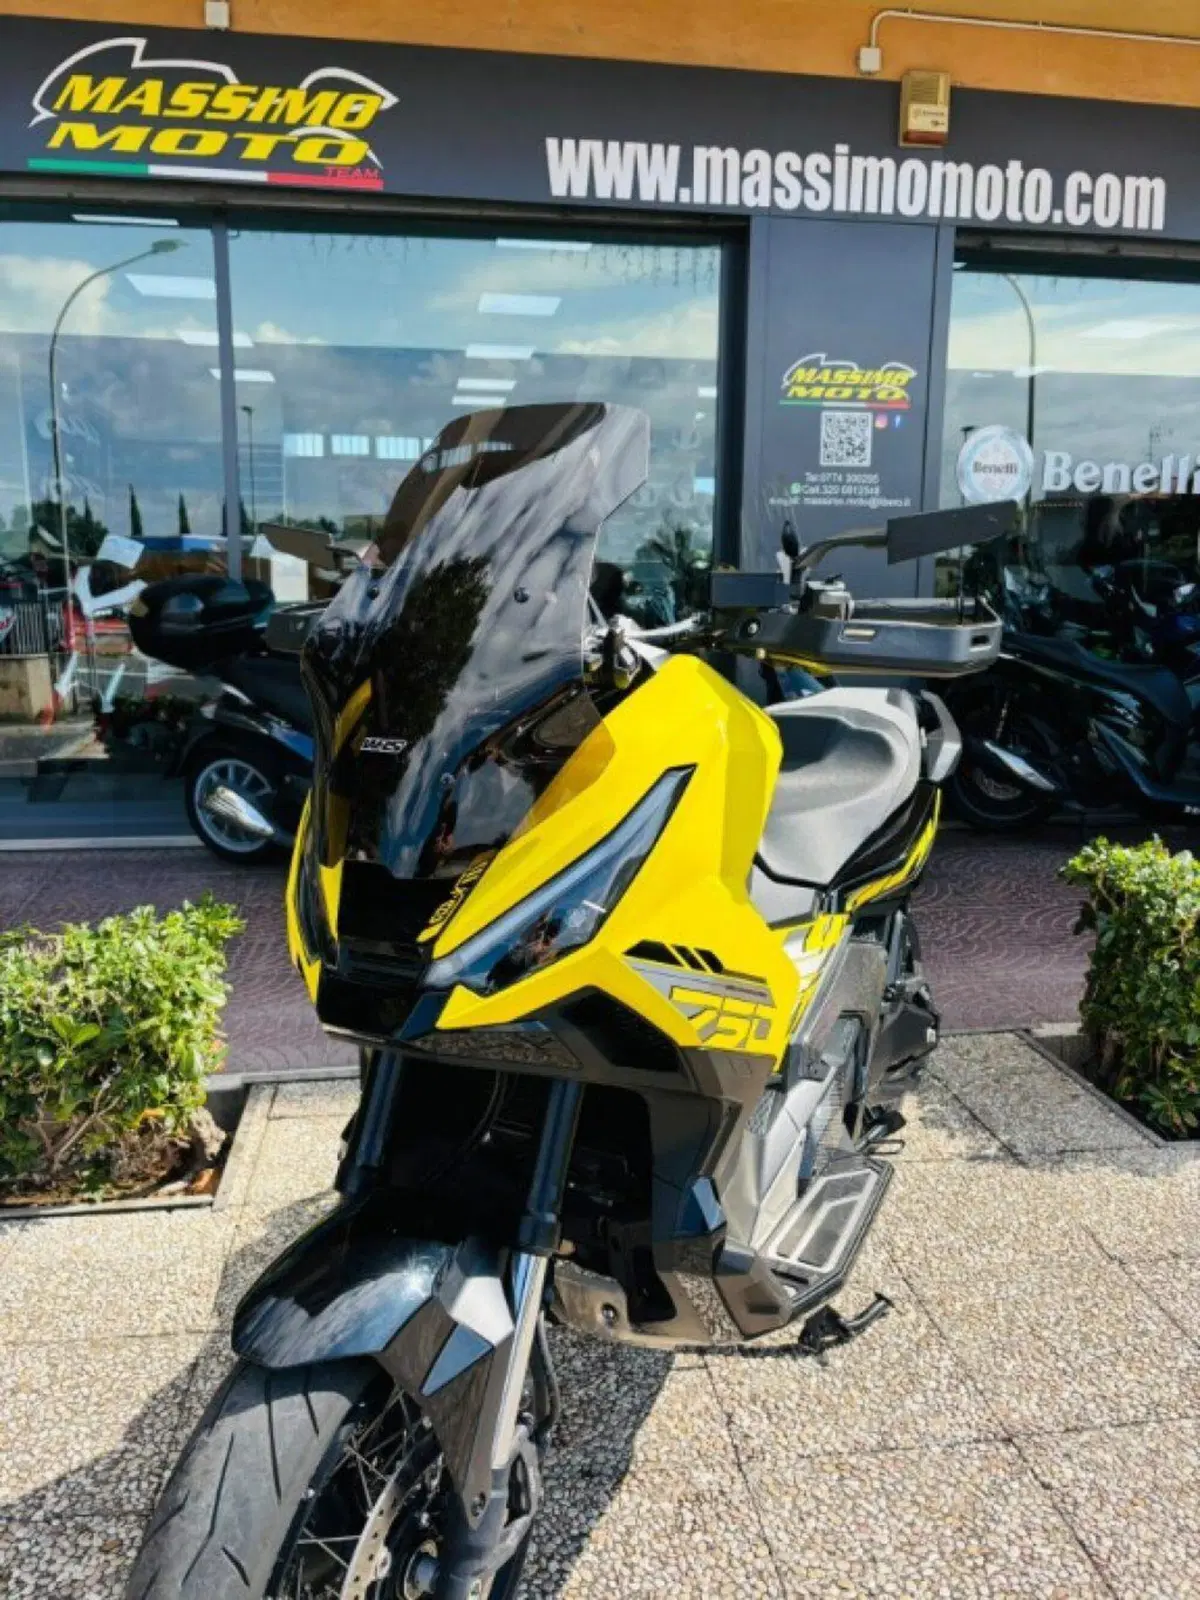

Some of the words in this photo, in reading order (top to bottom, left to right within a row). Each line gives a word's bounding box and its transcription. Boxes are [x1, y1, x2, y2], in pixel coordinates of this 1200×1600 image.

[53, 74, 386, 130] MASSIMO
[47, 121, 370, 166] MOTO
[324, 166, 380, 181] TEAM
[545, 136, 1166, 230] www.massimomoto.com
[787, 385, 907, 400] MOTO
[791, 367, 912, 386] MASSIMO
[668, 985, 778, 1052] 750
